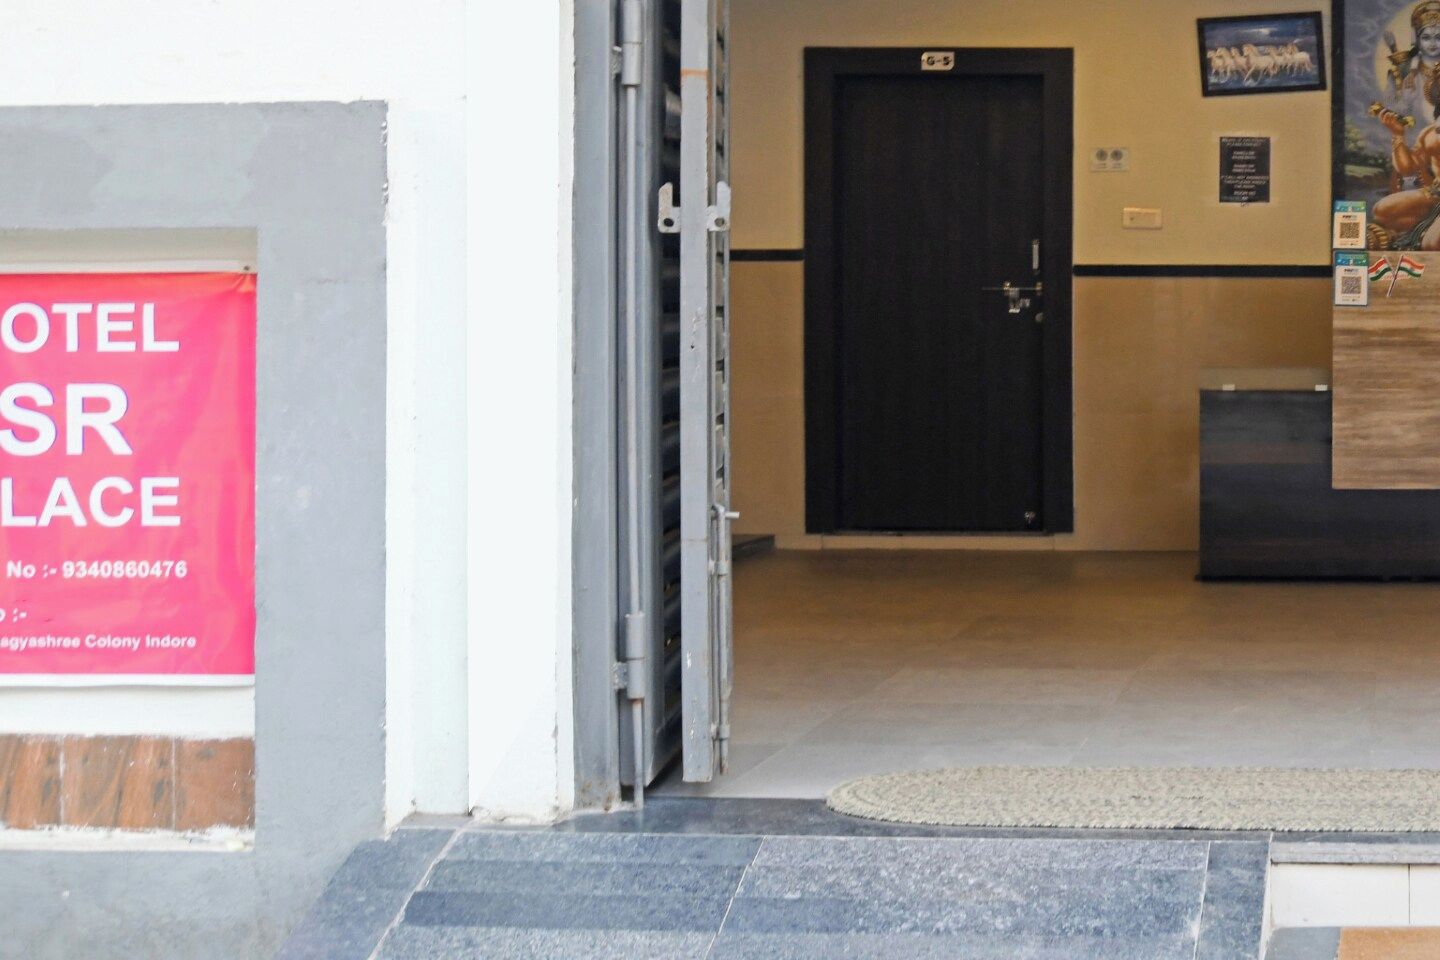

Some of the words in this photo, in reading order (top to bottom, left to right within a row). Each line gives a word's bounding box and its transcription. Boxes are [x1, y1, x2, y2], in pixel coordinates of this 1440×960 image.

[1, 302, 180, 353] OTEL
[0, 382, 133, 457] SR
[1, 476, 181, 528] LACE
[6, 560, 36, 578] No
[62, 560, 188, 579] 9340860476
[85, 634, 141, 651] Colony
[145, 634, 197, 648] Indore
